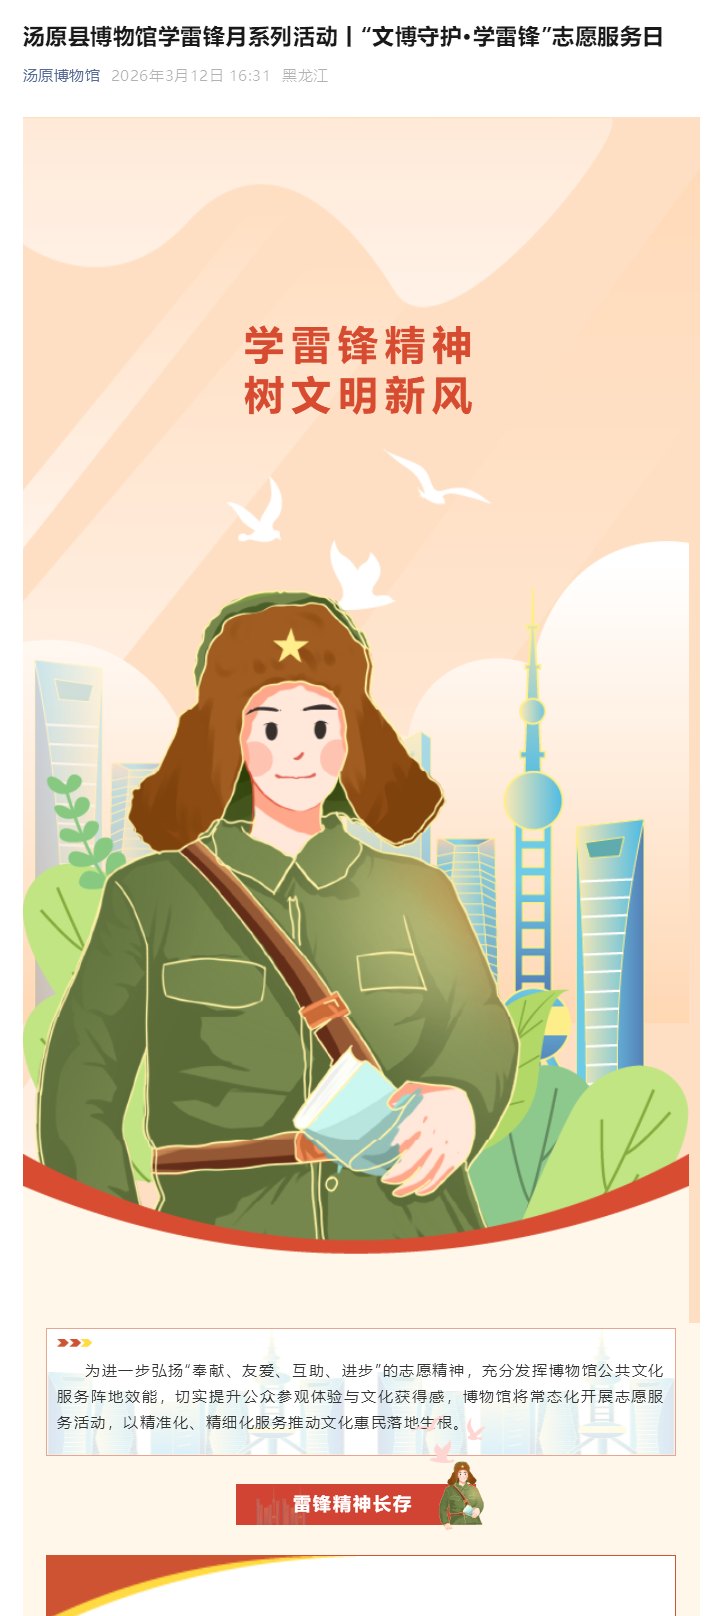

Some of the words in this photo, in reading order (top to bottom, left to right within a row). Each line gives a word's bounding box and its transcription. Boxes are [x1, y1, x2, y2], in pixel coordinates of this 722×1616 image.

[23, 68, 100, 83] 汤原博物馆
[112, 68, 223, 83] 2026年3月12日
[229, 68, 271, 83] 16:31
[282, 68, 328, 83] 黑龙江
[245, 325, 471, 365] 学雷锋精神
[245, 376, 472, 415] 树文明新风
[293, 1494, 412, 1514] 雷锋精神长存
